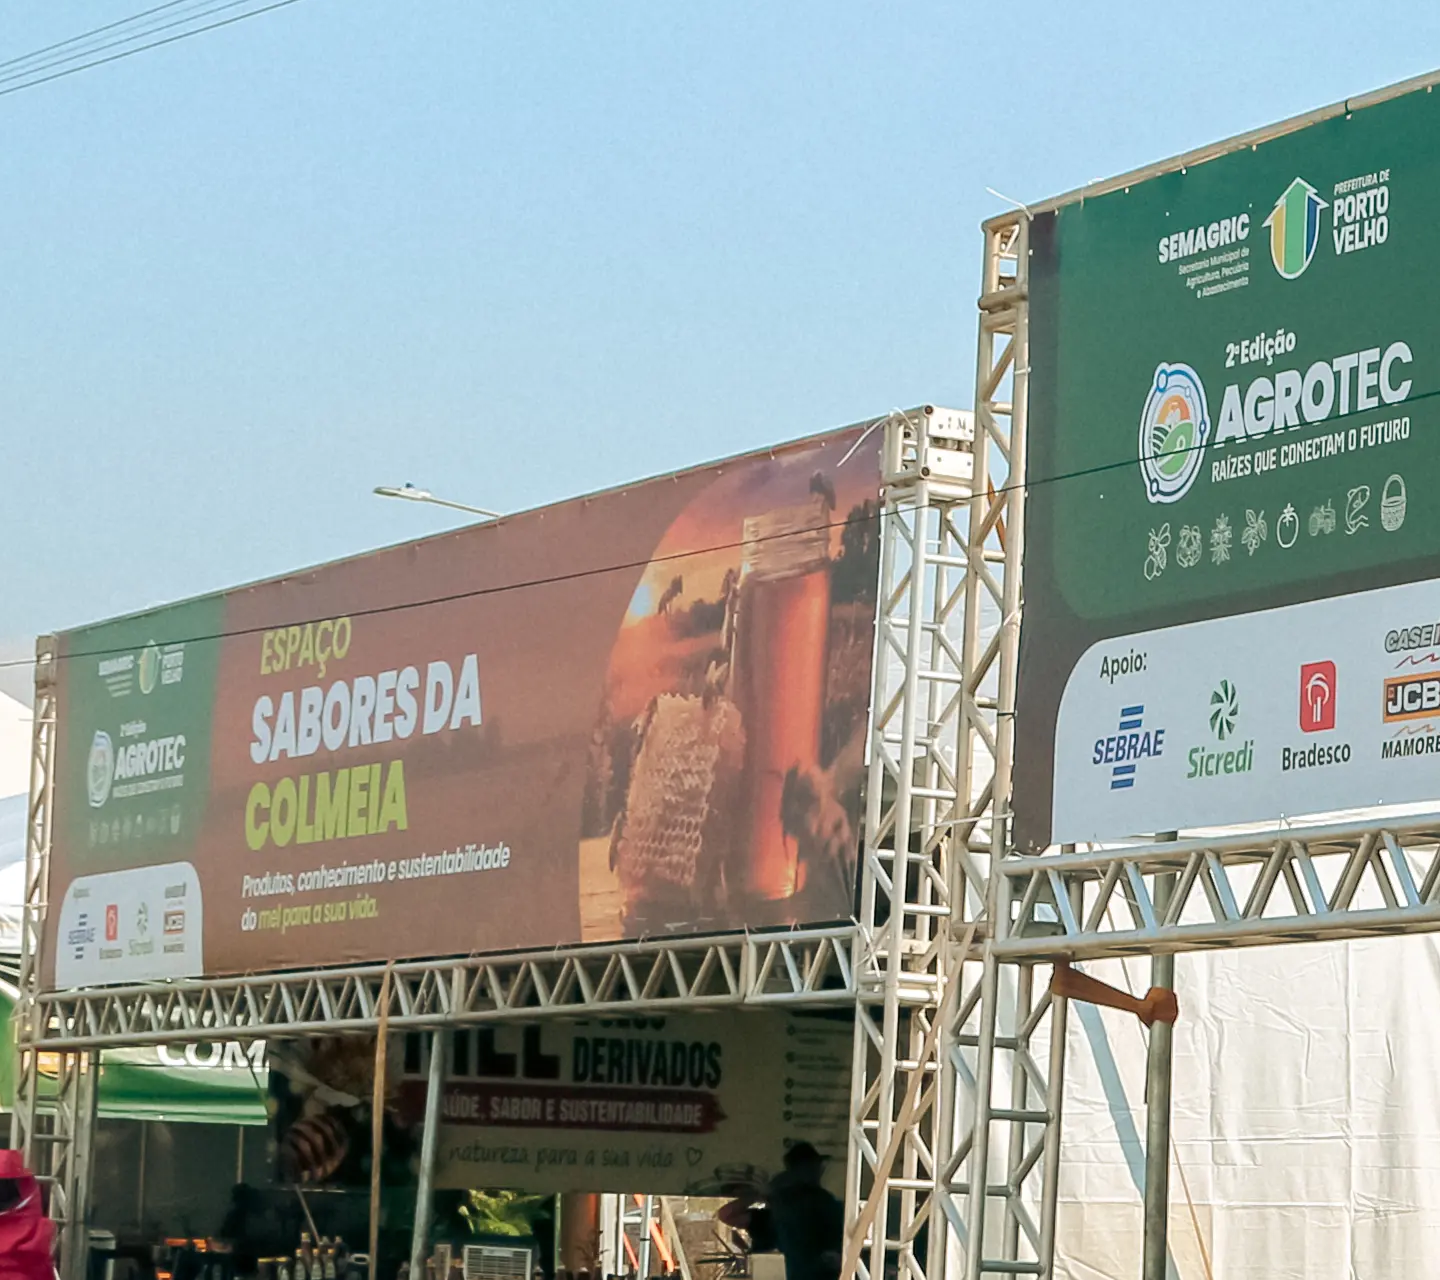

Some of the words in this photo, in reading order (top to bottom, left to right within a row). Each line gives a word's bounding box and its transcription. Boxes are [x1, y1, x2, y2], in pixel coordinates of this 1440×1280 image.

[1334, 176, 1377, 195] PREFEITURA
[1379, 168, 1390, 181] DE
[1333, 186, 1389, 227] PORTO
[1158, 213, 1250, 263] SEMAGRIC
[1333, 216, 1388, 255] VELHO
[1213, 341, 1413, 449] AGROTEC
[1211, 453, 1252, 483] RAÍZES
[1254, 450, 1277, 476] QUE
[1280, 431, 1345, 467] CONECTAM
[1348, 428, 1356, 451] O
[1360, 417, 1410, 448] FUTURO
[260, 616, 352, 678] ESPAÇO
[1384, 624, 1433, 653] CASE
[1099, 648, 1147, 684] Apoio:
[250, 666, 419, 763] SABORES
[422, 653, 482, 734] DA
[114, 735, 186, 781] AGROTEC
[1092, 729, 1165, 765] SEBRAE
[1187, 739, 1253, 778] Sicredi
[1282, 741, 1351, 771] Bradesco
[245, 760, 408, 850] COLMEIA
[242, 872, 295, 898] Produtos,
[297, 858, 386, 892] conhecimento
[388, 867, 397, 881] e
[397, 841, 510, 880] sustentabilidade
[241, 907, 257, 931] do
[258, 902, 280, 930] mel
[323, 902, 346, 922] sua
[573, 1036, 722, 1089] DERIVADOS
[442, 1089, 485, 1120] AÚDE,
[490, 1096, 541, 1121] SABOR
[545, 1098, 556, 1121] E
[559, 1098, 703, 1127] SUSTENTABILIDADE
[449, 1139, 528, 1164] natureza
[535, 1147, 578, 1173] para
[585, 1150, 595, 1166] a
[602, 1148, 629, 1166] sua
[636, 1144, 673, 1166] vida
